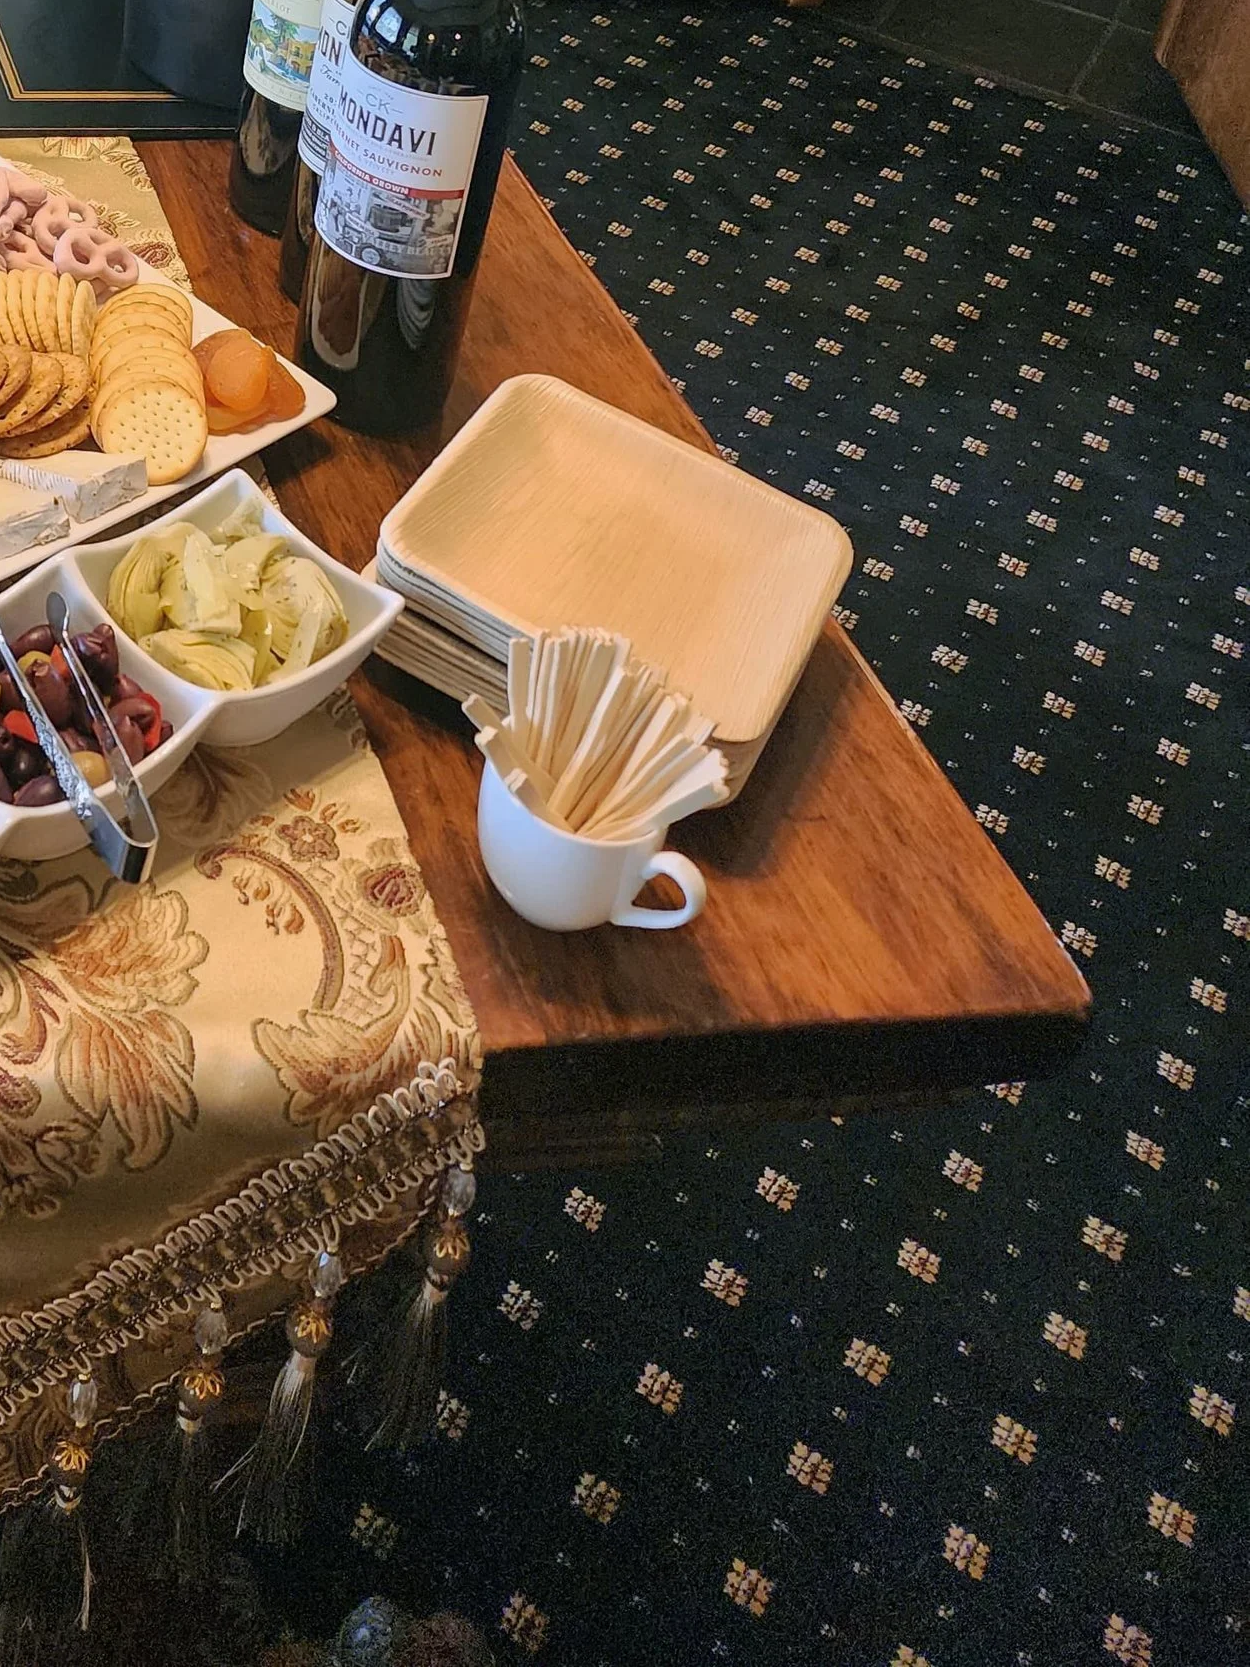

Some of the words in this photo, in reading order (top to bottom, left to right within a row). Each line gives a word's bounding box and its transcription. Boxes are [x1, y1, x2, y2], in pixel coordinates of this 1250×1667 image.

[365, 93, 392, 115] CK
[338, 84, 437, 156] MONDAVI
[363, 148, 443, 178] SAUVIGNON
[372, 177, 409, 195] GROWN
